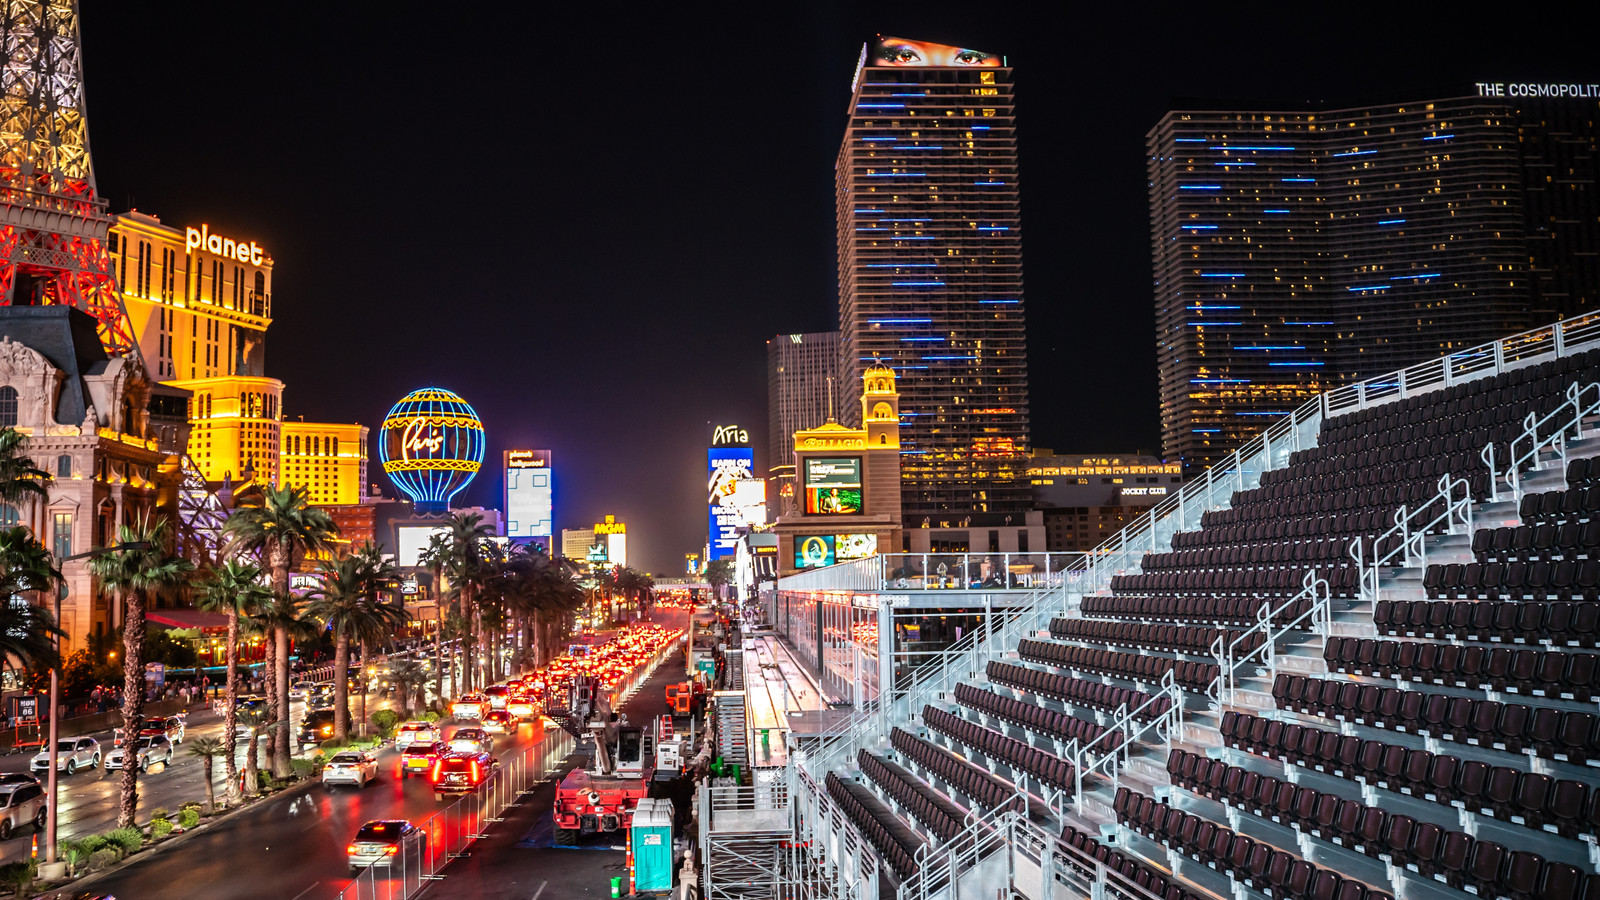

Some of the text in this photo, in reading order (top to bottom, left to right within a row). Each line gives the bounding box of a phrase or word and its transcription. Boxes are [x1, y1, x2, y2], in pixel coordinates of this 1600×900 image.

[1475, 83, 1600, 98] THE COSMOPOLIT
[185, 223, 264, 267] planet
[402, 416, 444, 465] Paris
[712, 425, 749, 445] Aria
[804, 437, 863, 449] BELLAGIO
[509, 459, 545, 469] hollywood
[1149, 487, 1166, 495] CLUB
[594, 523, 626, 535] MGM
